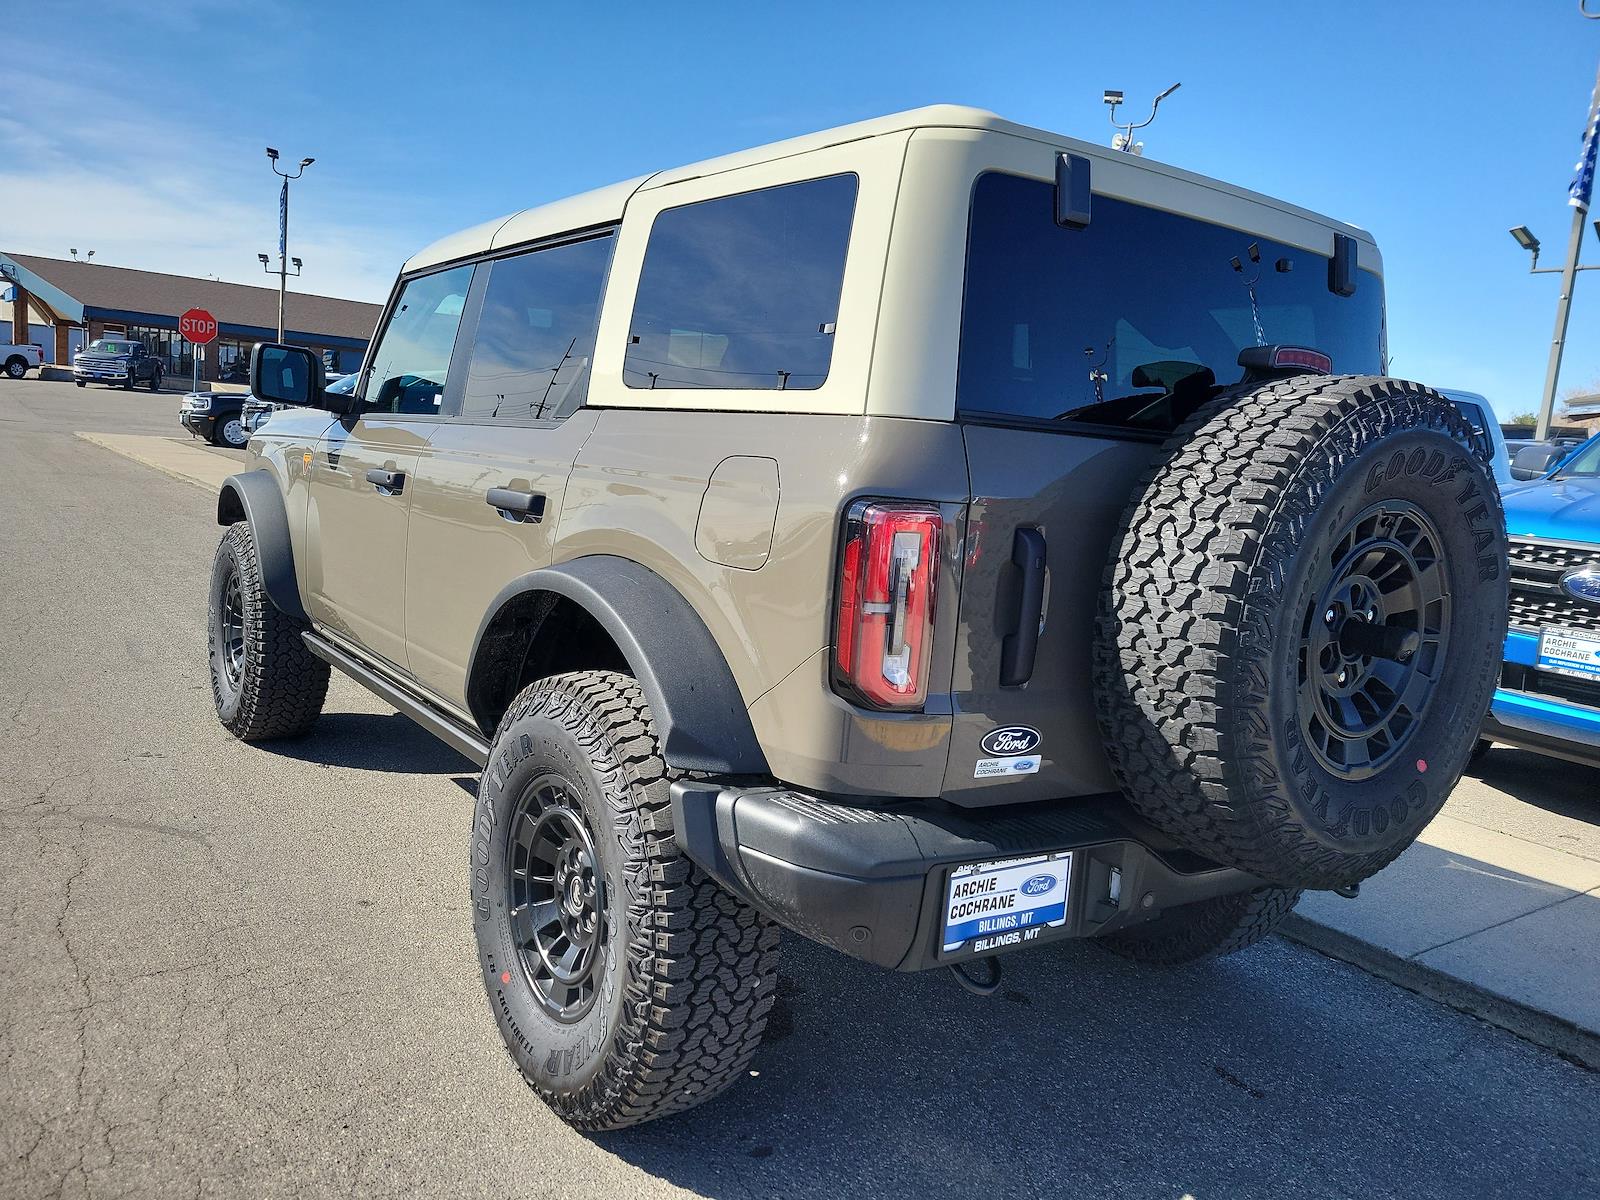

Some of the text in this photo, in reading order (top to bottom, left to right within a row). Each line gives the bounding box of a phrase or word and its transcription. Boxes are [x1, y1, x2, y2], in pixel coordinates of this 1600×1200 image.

[182, 319, 215, 334] STOP
[1544, 647, 1591, 661] COCHRANE
[1546, 638, 1577, 649] ARCHIE
[993, 731, 1031, 751] Ford
[953, 876, 1051, 899] ARCHIE Ford
[950, 894, 1016, 920] COCHRANE
[978, 912, 1034, 933] BILLINGS, MT
[974, 928, 1041, 953] BILLINGS, MT
[496, 988, 535, 1056] TERRITORY
